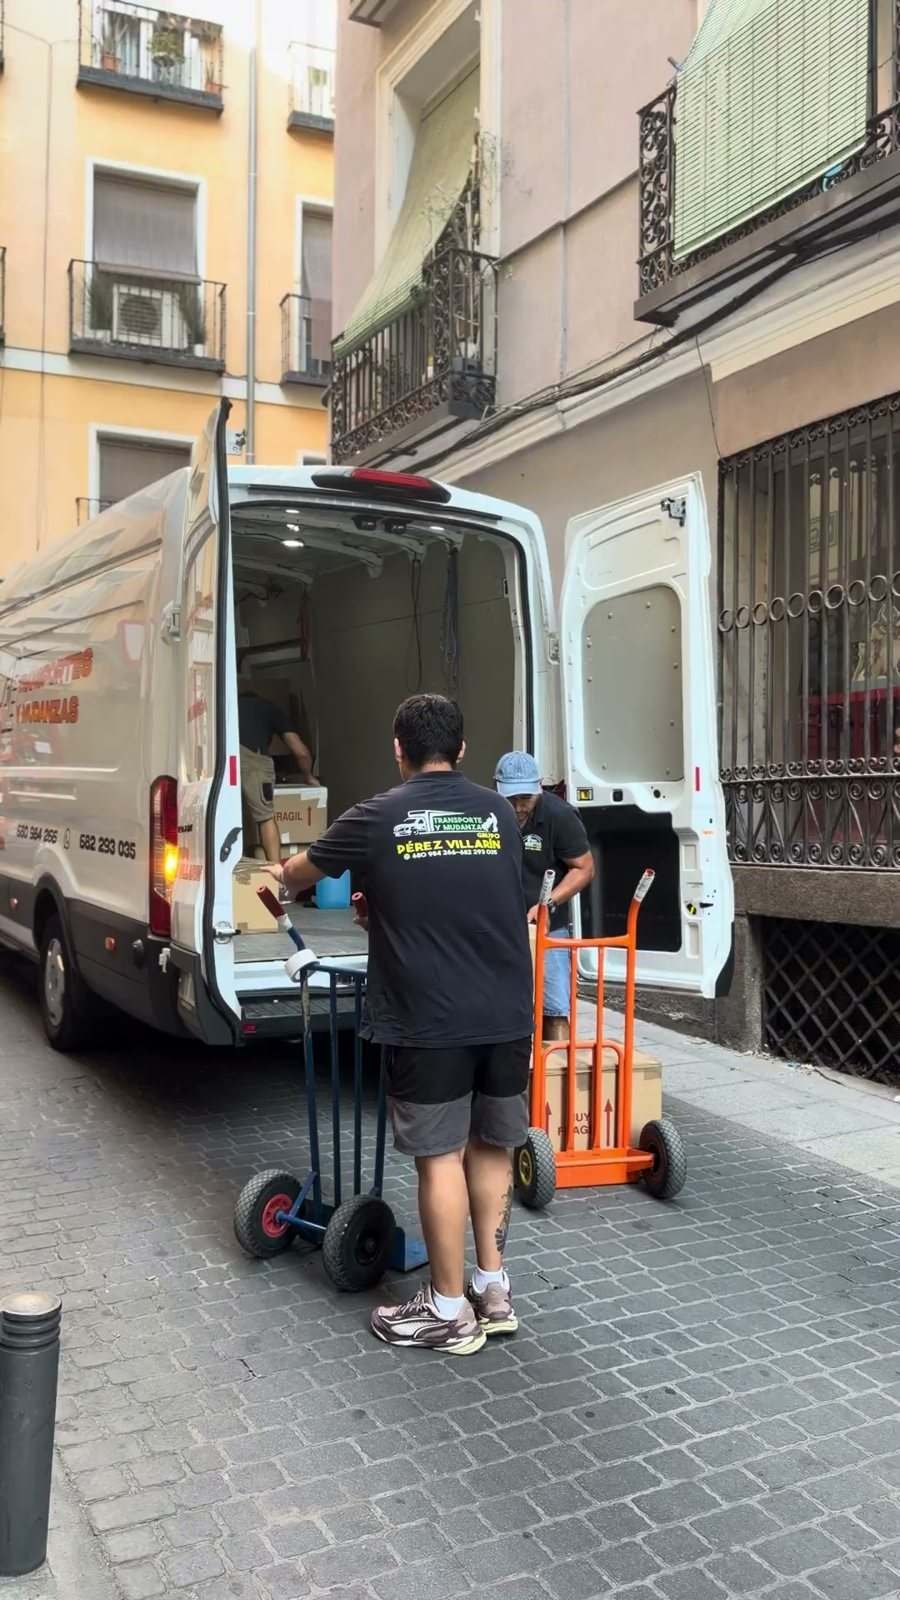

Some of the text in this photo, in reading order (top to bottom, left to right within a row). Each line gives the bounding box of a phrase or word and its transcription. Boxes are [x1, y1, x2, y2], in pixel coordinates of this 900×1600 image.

[80, 833, 96, 852] 682
[98, 836, 115, 856] 293
[118, 840, 136, 860] 035
[397, 838, 501, 854] PÉREZ VILLARÍN
